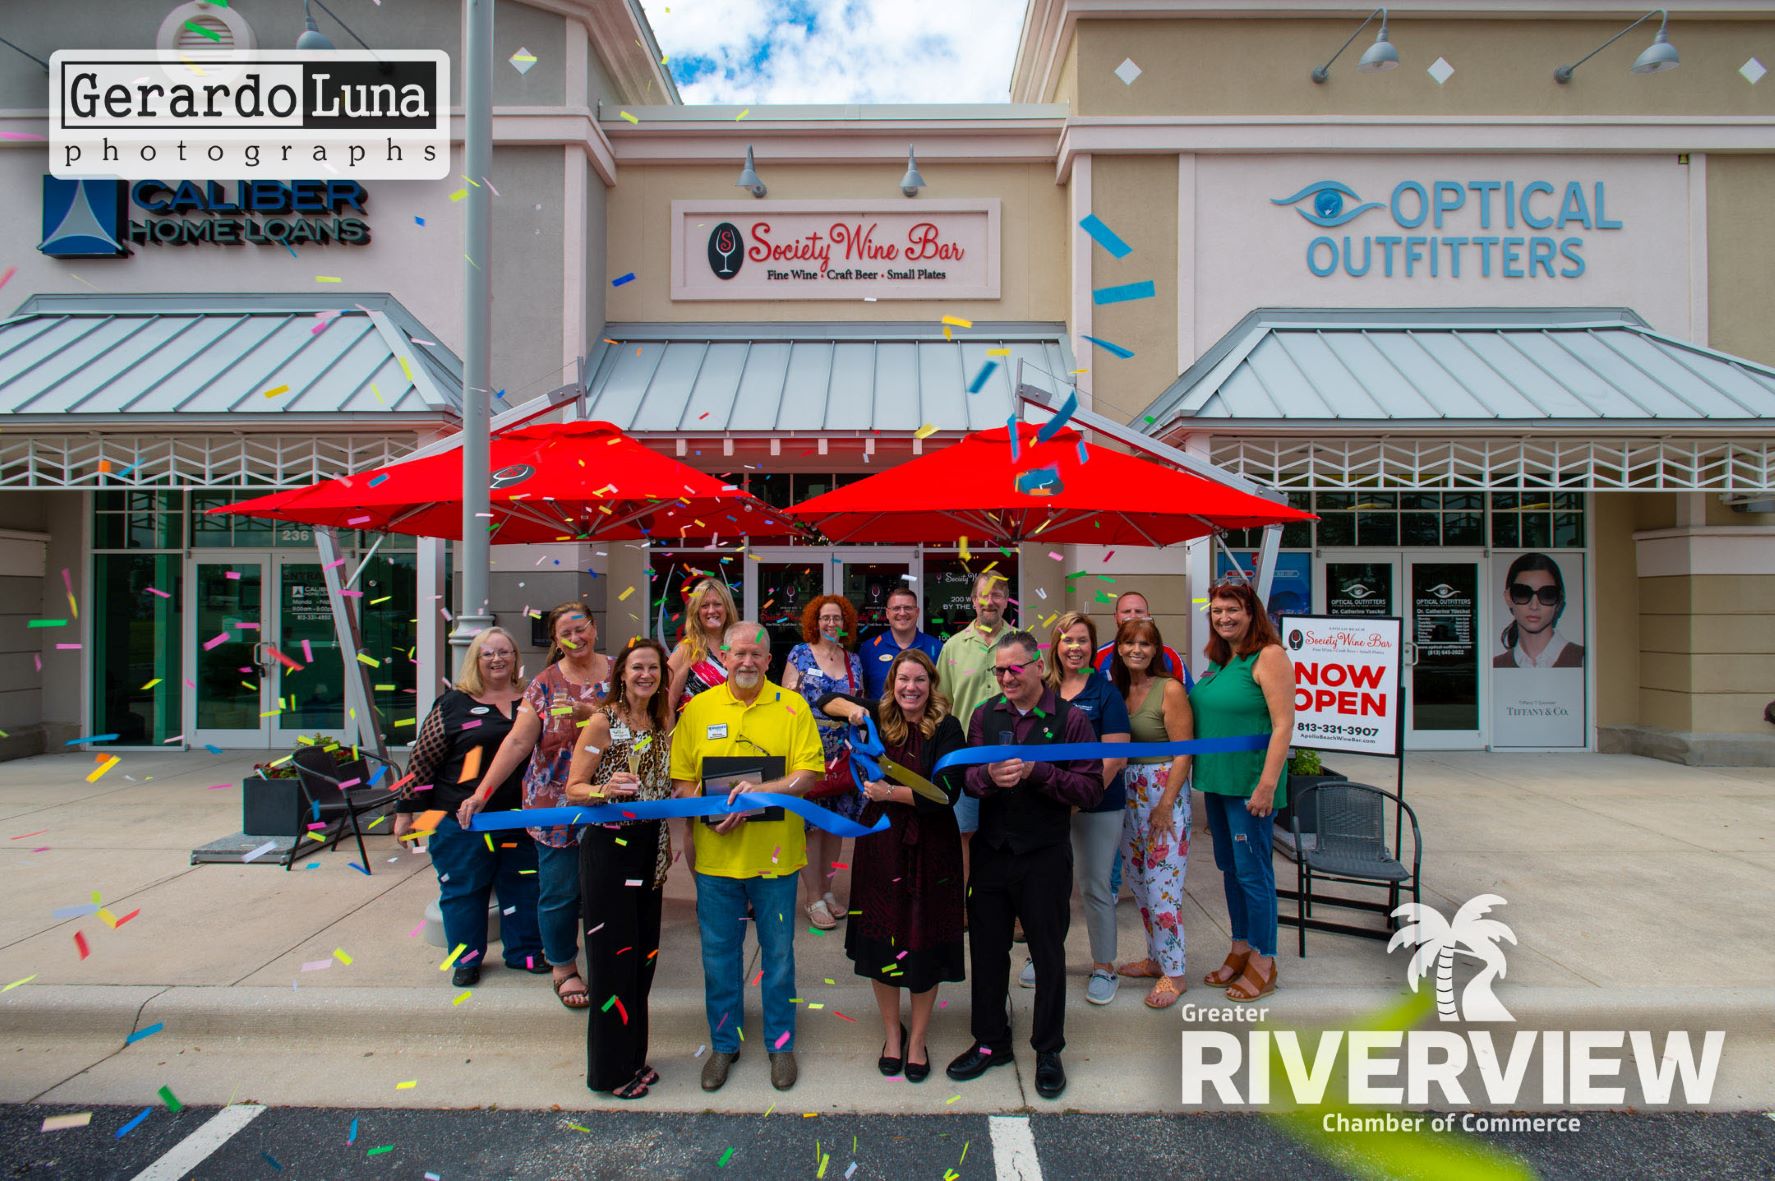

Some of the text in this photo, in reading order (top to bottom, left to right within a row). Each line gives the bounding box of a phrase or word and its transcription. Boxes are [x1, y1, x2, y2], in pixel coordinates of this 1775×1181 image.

[131, 179, 364, 212] CALIBER
[1391, 180, 1623, 229] OPTICAL
[129, 218, 364, 243] HOME LOANS
[748, 222, 965, 272] Society Wine Bar
[1307, 236, 1586, 278] OUTFITTERS
[767, 269, 946, 280] Fine Wine Craft Beer Small Plates
[282, 530, 309, 541] 236
[1305, 631, 1392, 649] Society Wine Bar
[1295, 662, 1386, 689] NOW
[1295, 688, 1386, 717] OPEN
[1297, 722, 1379, 736] 813-331-3907
[1300, 733, 1376, 744] ApolloBeachWineBar.com
